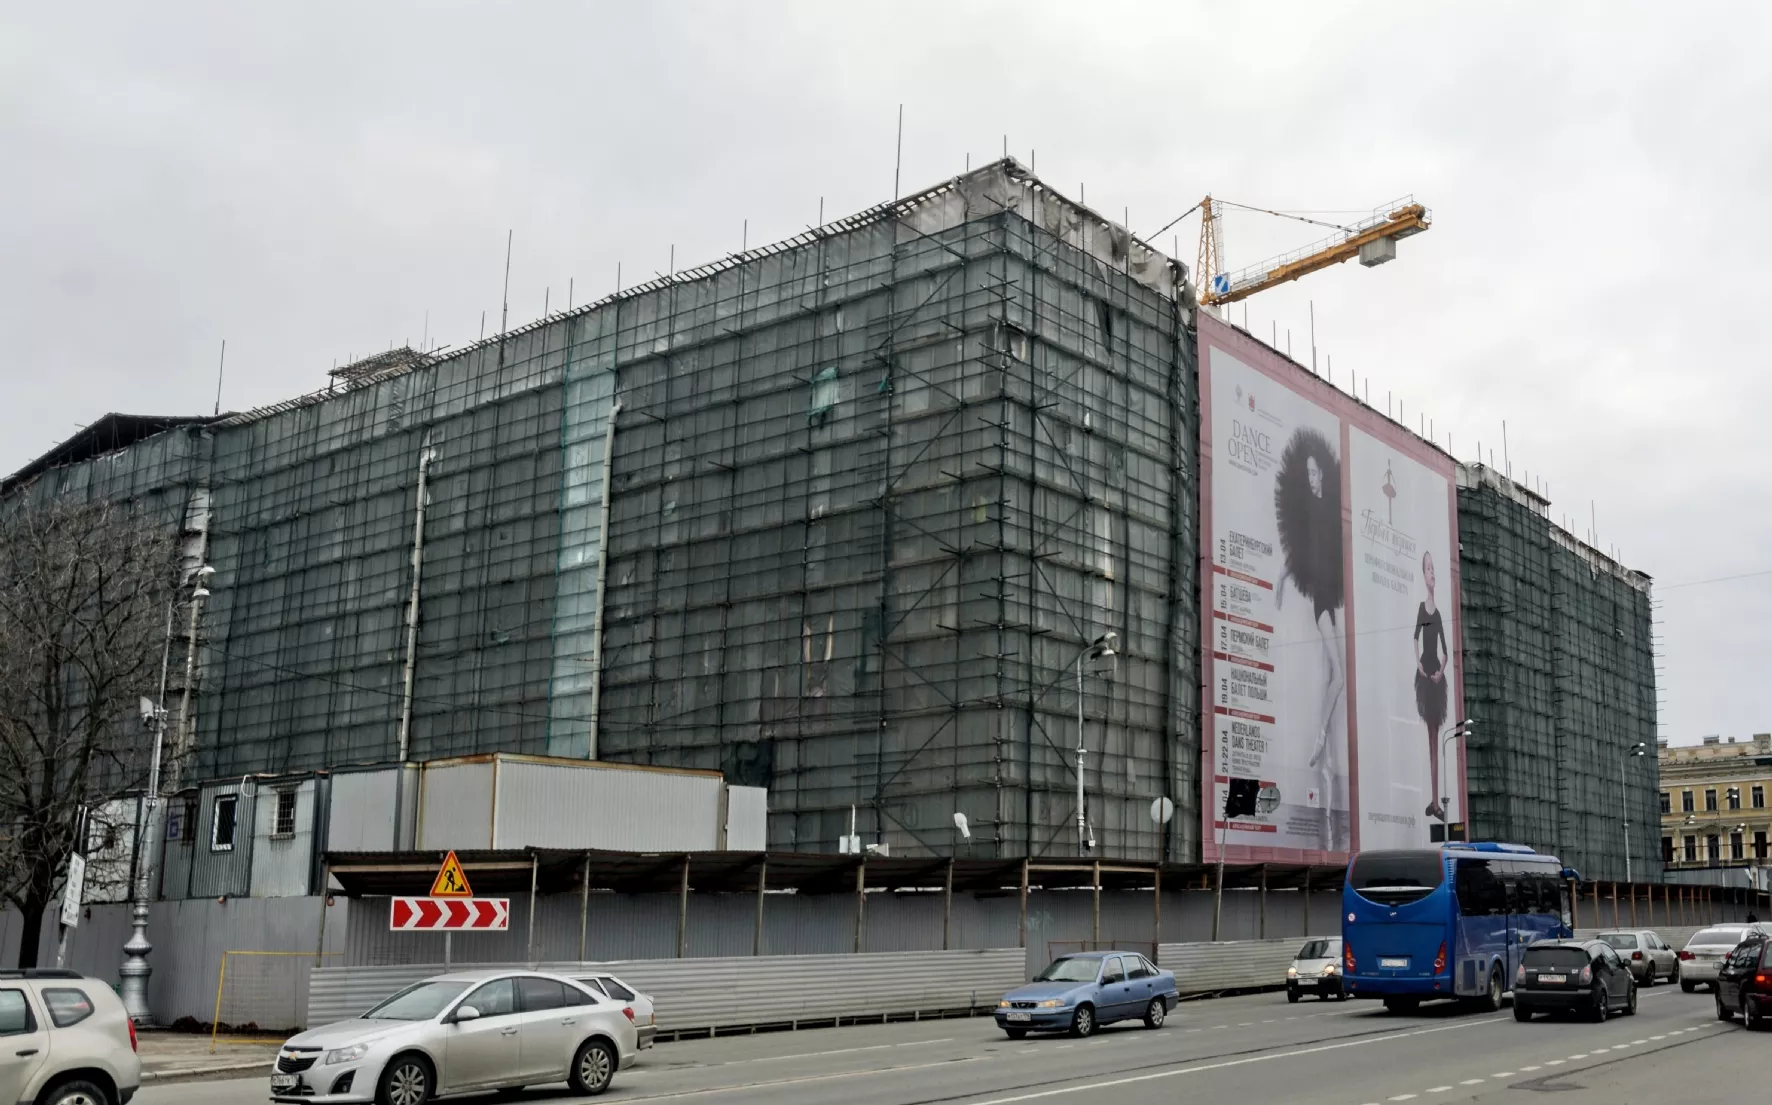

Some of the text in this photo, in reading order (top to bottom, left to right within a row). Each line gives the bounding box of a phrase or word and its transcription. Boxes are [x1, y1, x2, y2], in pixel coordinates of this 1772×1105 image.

[1233, 419, 1271, 454] DANCE
[1228, 438, 1258, 467] OPEN
[1229, 530, 1273, 556] ЕКАТЕРИНБУРГСКИЙ
[1230, 544, 1244, 560] БАЛЕТ
[1231, 629, 1269, 650] ПЕРМСКИЙ БАЛЕТ
[1231, 667, 1267, 687] НАЦИОНАЛЬНЫЙ
[1231, 682, 1246, 696] БАЛЕТ
[1232, 721, 1260, 738] NEDERLANDS
[1232, 735, 1244, 749] DANS
[1246, 738, 1264, 753] THEATER
